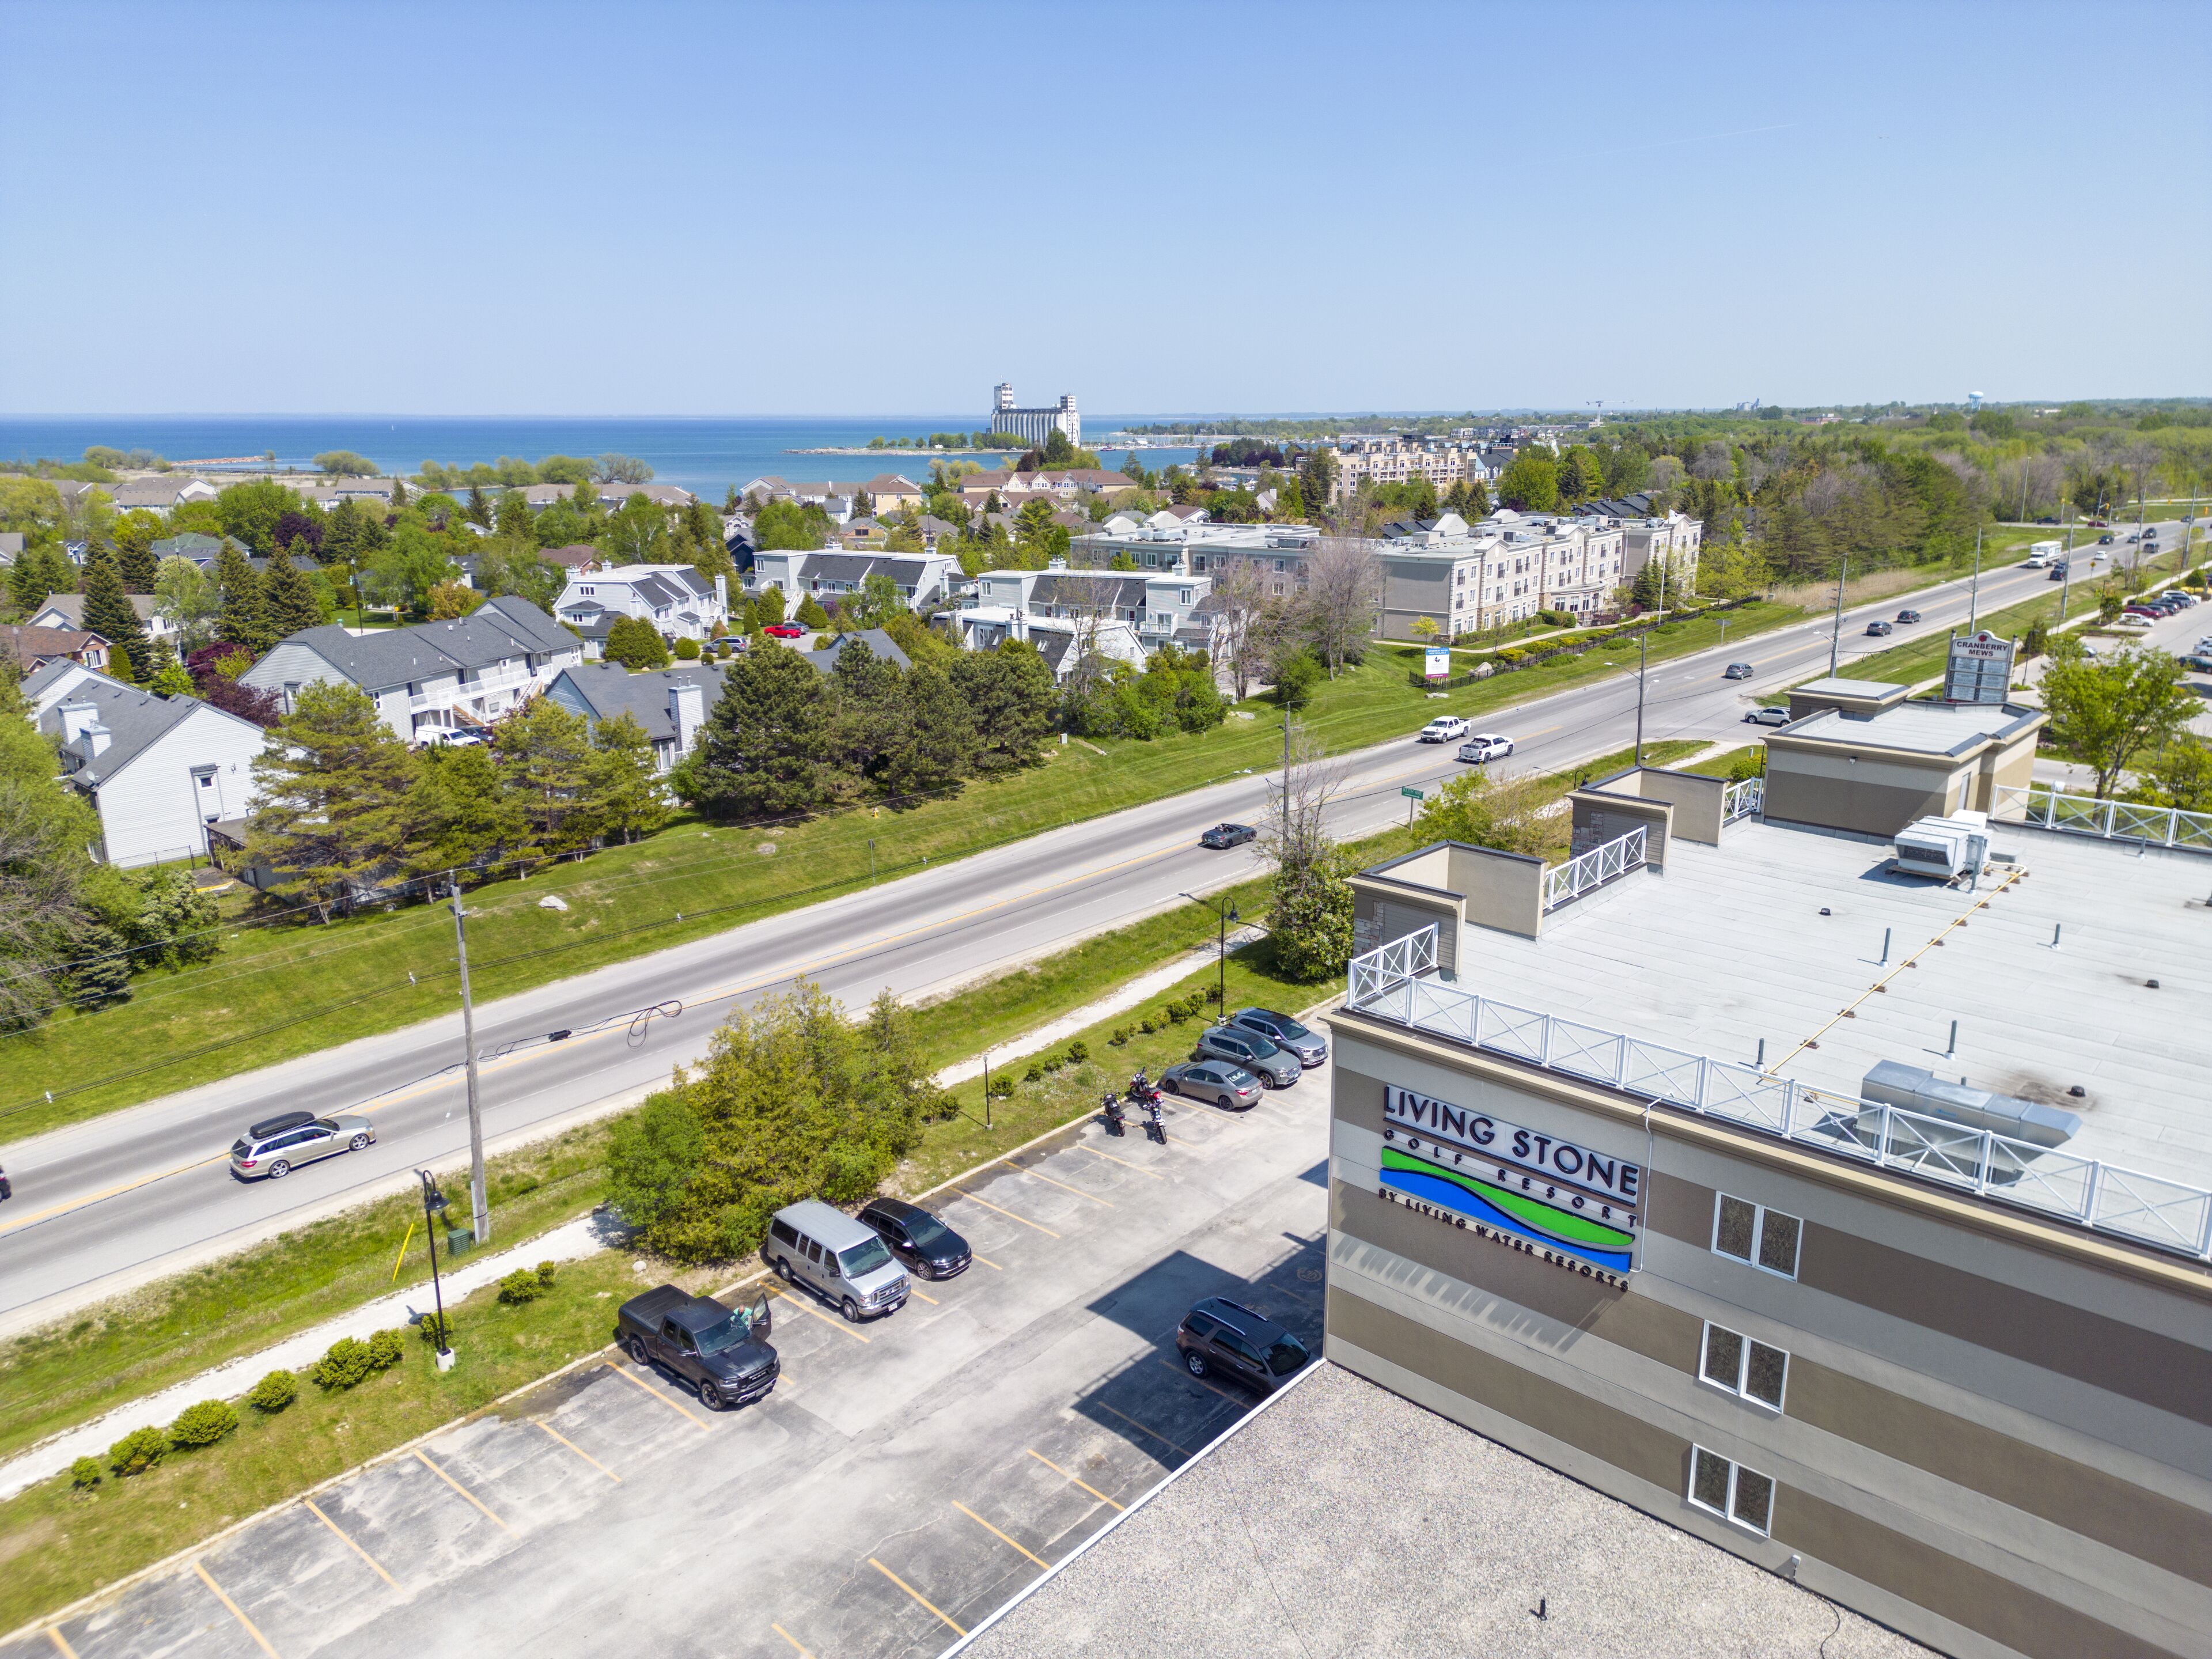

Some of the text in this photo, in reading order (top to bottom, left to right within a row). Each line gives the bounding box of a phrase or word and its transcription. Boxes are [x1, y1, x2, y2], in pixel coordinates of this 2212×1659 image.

[1957, 641, 2008, 651] CRANBERRY
[1383, 1086, 1638, 1196] LIVING STONE
[1383, 1129, 1637, 1228] GOLF RESORT
[1378, 1188, 1629, 1292] BY LIVING WATER RESORTS
